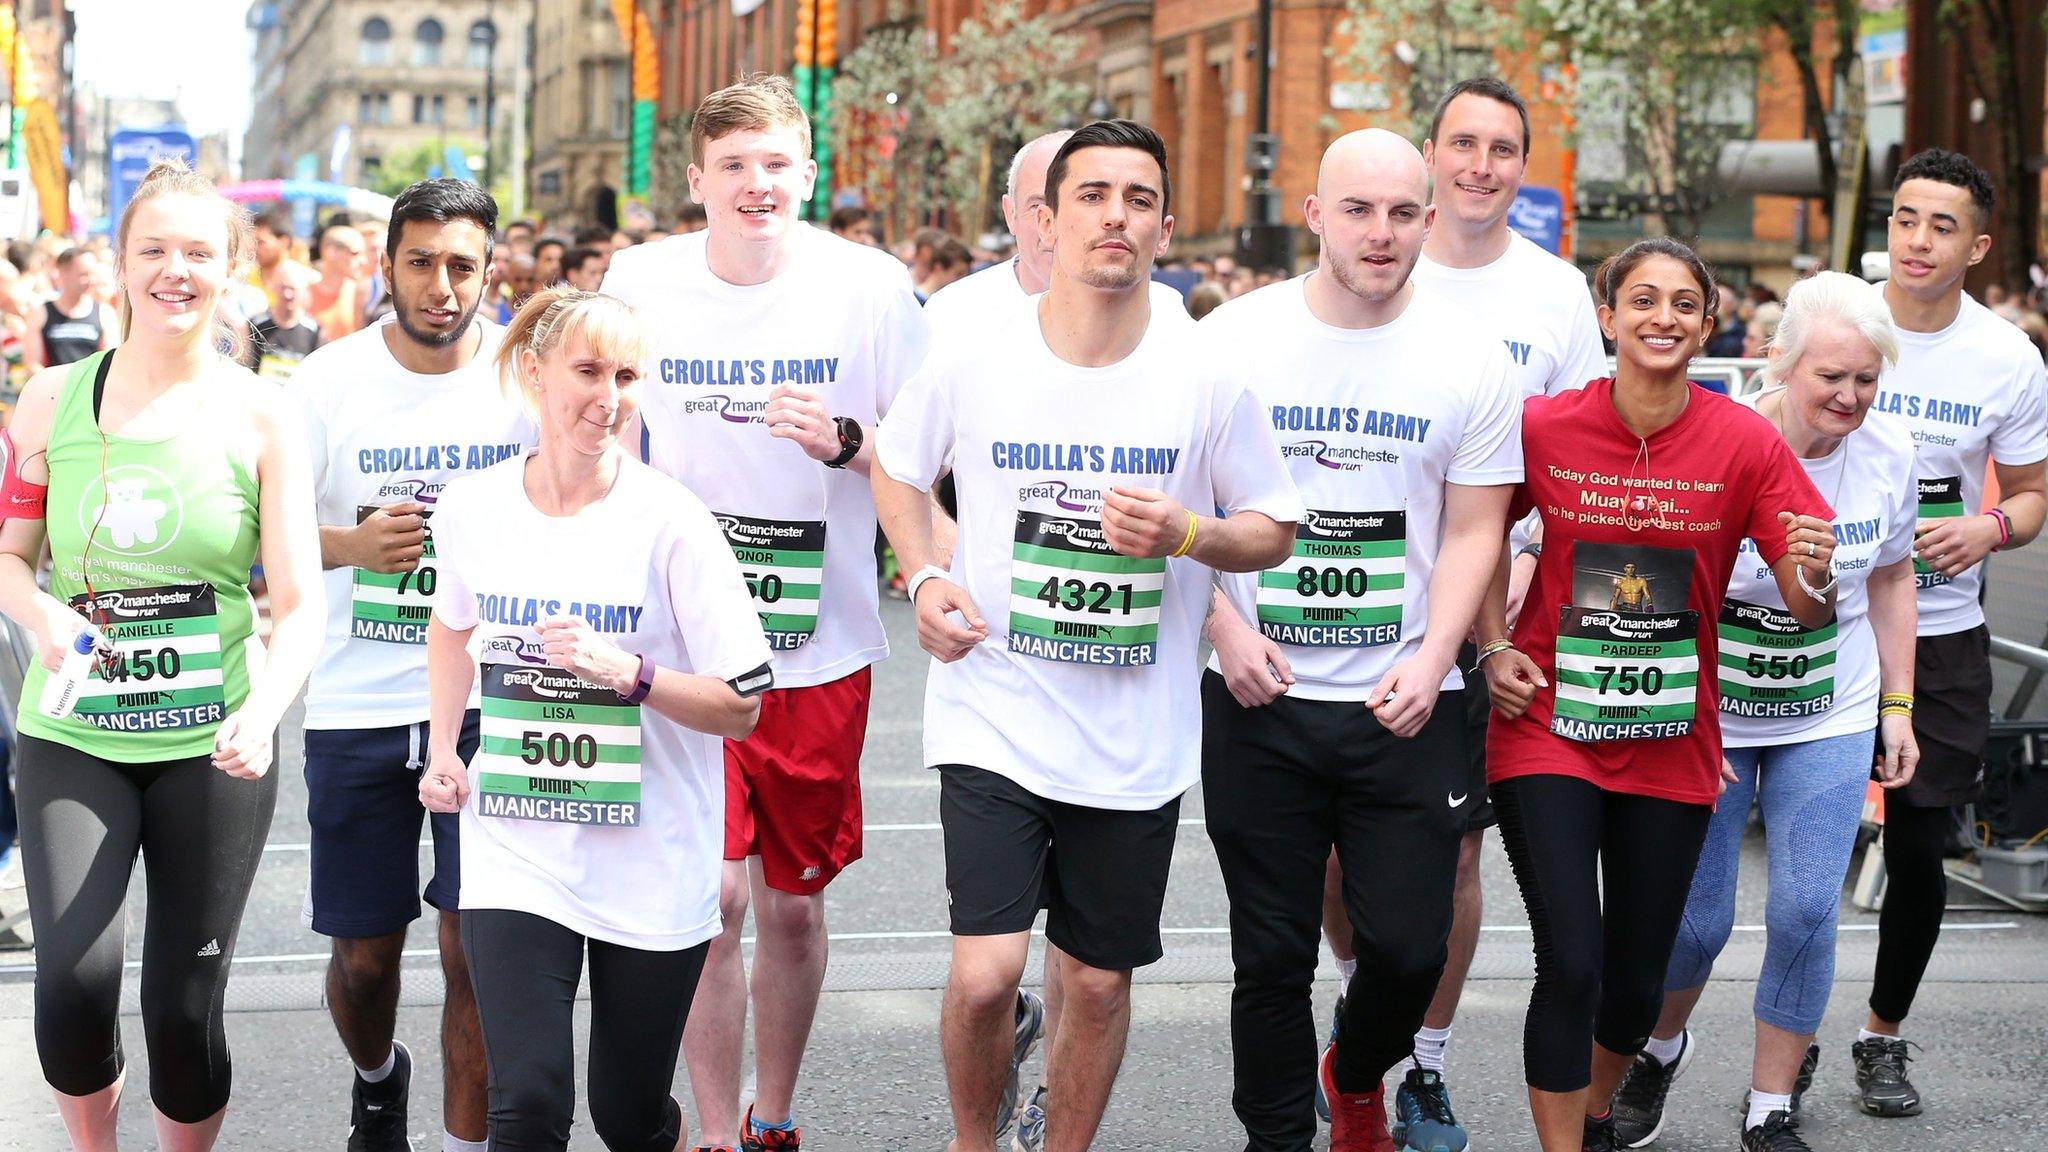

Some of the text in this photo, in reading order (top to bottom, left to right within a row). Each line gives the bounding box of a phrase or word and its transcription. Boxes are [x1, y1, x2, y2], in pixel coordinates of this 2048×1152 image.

[660, 358, 839, 385] CROLLA'S ARMY
[685, 399, 718, 413] great
[1871, 391, 1983, 427] LA'S ARMY
[750, 416, 766, 424] ru
[1271, 405, 1431, 443] ROLLA'S ARMY
[1911, 430, 1957, 446] chester
[358, 443, 521, 474] CROLLA'S ARMY
[992, 441, 1180, 475] CROLLA'S ARMY
[1281, 444, 1400, 464] great manchester
[1340, 461, 1362, 471] run
[1547, 465, 1724, 492] Today God wanted to learn
[379, 483, 414, 496] great
[1019, 485, 1054, 501] great
[1918, 483, 1949, 493] hester
[1580, 490, 1628, 512] Muay
[1086, 505, 1101, 513] ru
[1319, 516, 1384, 528] manchester
[1548, 504, 1559, 515] so
[1560, 505, 1575, 520] he
[1578, 511, 1624, 526] picked
[1655, 517, 1684, 531] best
[1688, 519, 1721, 532] coach
[739, 524, 804, 538] manchester
[1039, 522, 1068, 535] great
[1331, 530, 1353, 538] run
[1832, 518, 1881, 546] ARMY
[751, 537, 772, 545] run
[735, 550, 774, 563] ONOR
[1304, 543, 1361, 556] THOMAS
[73, 556, 192, 575] royal manchester
[1835, 557, 1869, 570] hester
[1296, 566, 1368, 598] 800
[86, 592, 191, 613] geat manchester
[1037, 576, 1133, 615] 4321
[138, 608, 159, 617] run
[476, 593, 643, 633] ROLLA'S ARMY
[1303, 607, 1345, 621] PUMA
[1736, 607, 1763, 619] great
[1054, 621, 1098, 638] PUMA
[1581, 615, 1680, 630] great manchester
[108, 623, 174, 638] DANIELLE
[357, 620, 428, 641] MANCH
[1263, 622, 1398, 644] MANCHESTER
[1632, 631, 1653, 639] run
[483, 640, 514, 653] reat
[1756, 635, 1805, 646] MARION
[1012, 633, 1152, 665] MANCHESTER
[1601, 644, 1662, 656] PARDEEP
[105, 647, 181, 682] 450
[1746, 652, 1809, 680] 550
[503, 673, 533, 686] great
[1594, 665, 1663, 696] 750
[117, 692, 160, 707] PUMA
[558, 691, 580, 700] run
[1750, 687, 1787, 698] PUMA
[73, 704, 221, 730] MANCHESTER
[543, 706, 575, 719] LISA
[1598, 705, 1638, 719] PUMA
[1555, 717, 1689, 740] MANCHESTER
[521, 731, 597, 768] 500
[529, 777, 573, 794] PUMA
[484, 795, 635, 824] MANCHESTER
